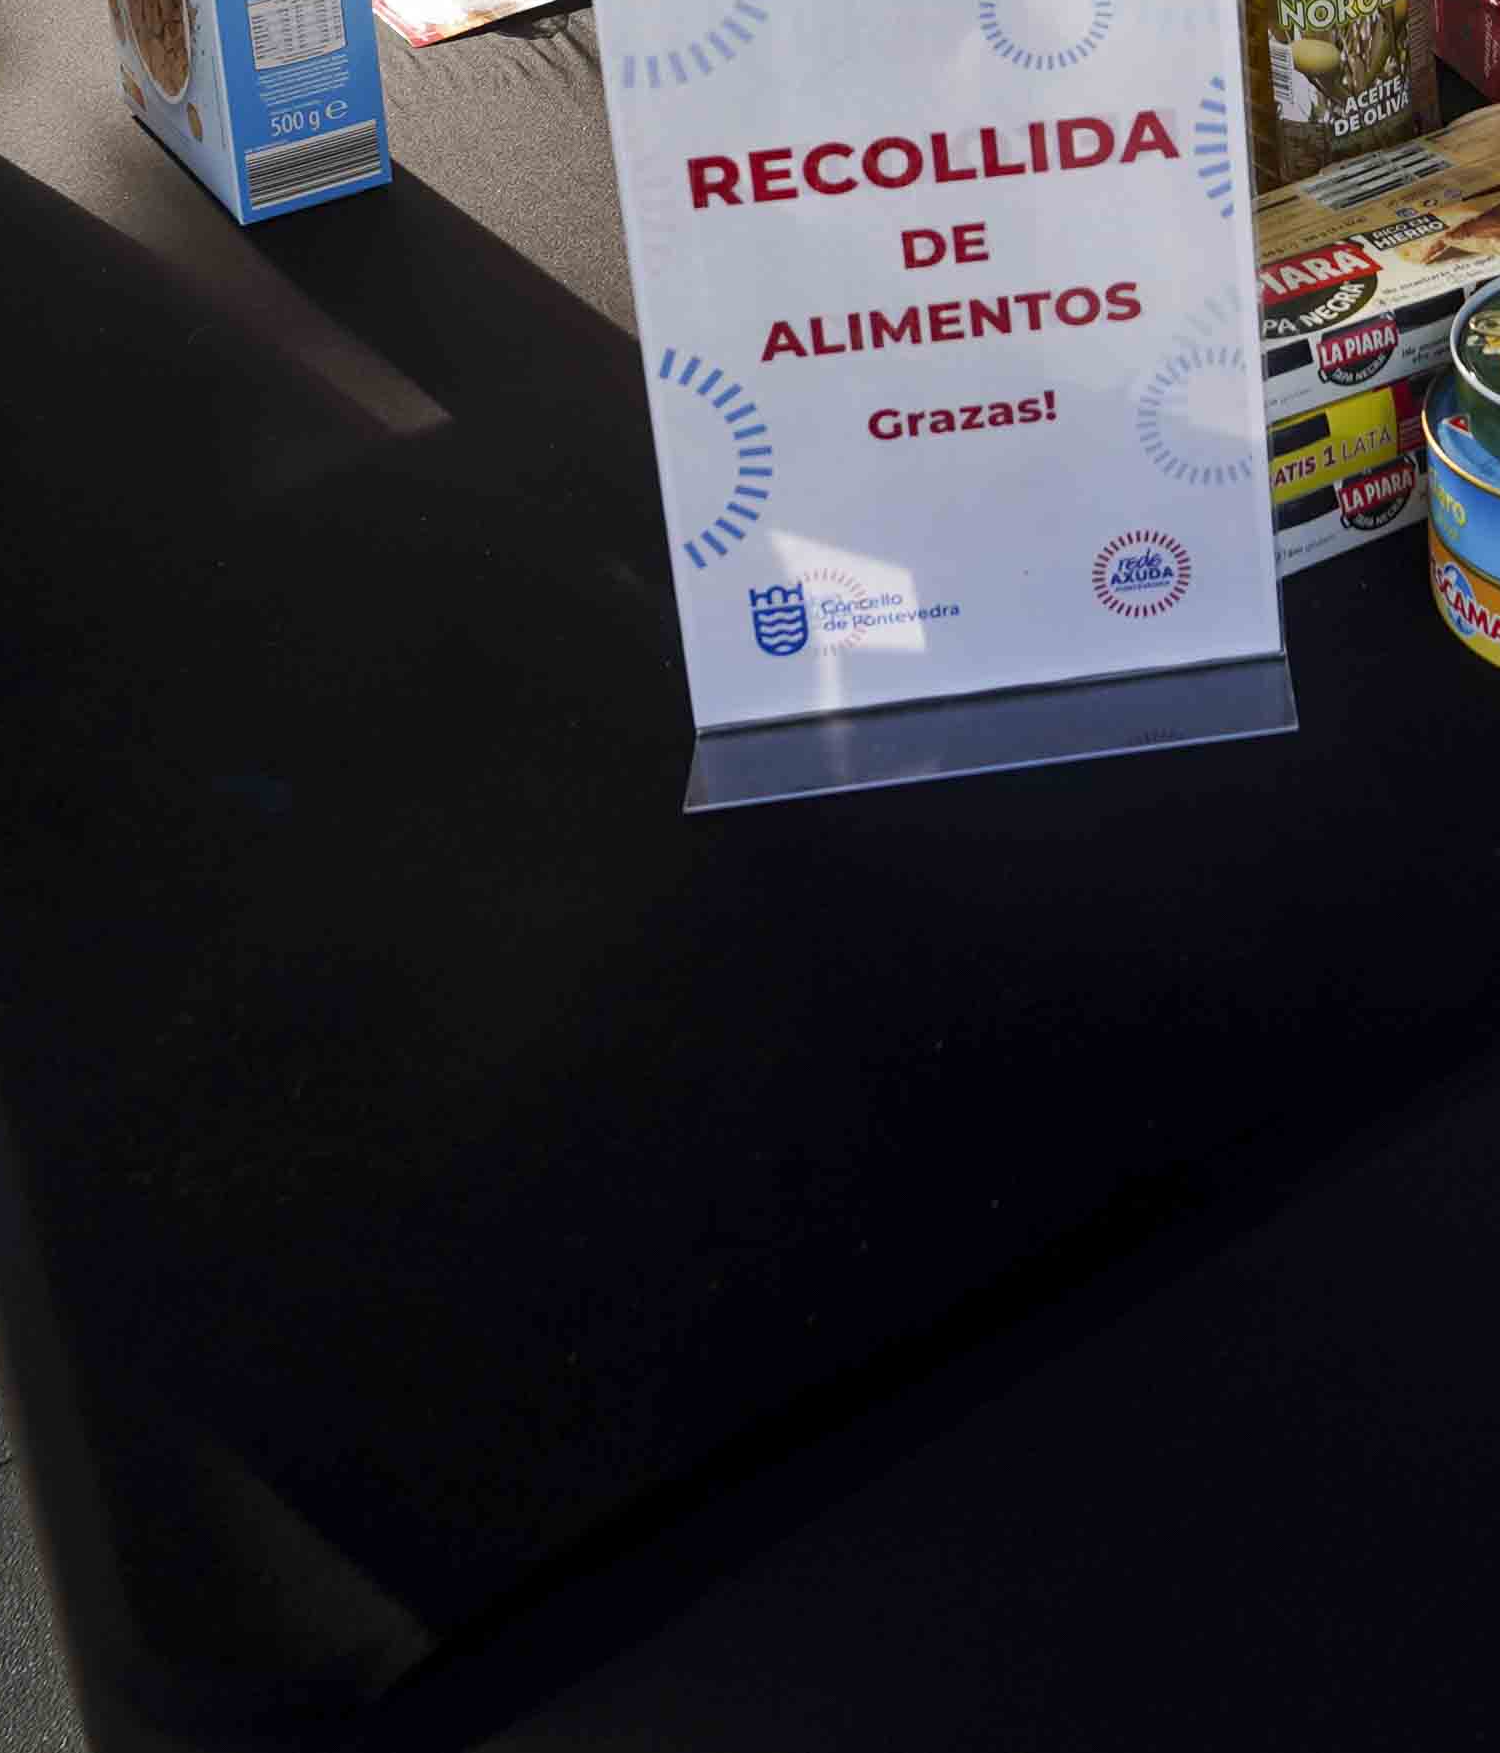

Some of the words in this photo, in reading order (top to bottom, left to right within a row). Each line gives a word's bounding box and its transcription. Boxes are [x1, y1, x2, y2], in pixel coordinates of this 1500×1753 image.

[1333, 113, 1361, 136] DE
[1363, 91, 1410, 125] OLIVA
[1345, 75, 1403, 113] ACEITE
[271, 110, 305, 136] 500
[309, 108, 320, 131] g
[686, 110, 1180, 209] RECOLLIDA
[901, 222, 991, 271] DE
[1374, 220, 1446, 249] HIERRO
[1260, 249, 1371, 296] IARA
[760, 280, 1143, 363] ALIMENTOS
[1261, 317, 1298, 335] PA
[1301, 281, 1365, 328] NEGRA
[1320, 342, 1345, 366] LA
[1348, 325, 1396, 356] PIARA
[866, 390, 1058, 441] Grazas!
[1271, 456, 1316, 487] ATIS
[1323, 444, 1336, 467] 1
[1340, 429, 1392, 458] LATA
[1341, 488, 1362, 510] LA
[1365, 469, 1414, 502] PIARA
[1110, 567, 1175, 586] AXUDA
[1117, 548, 1164, 571] rede
[821, 592, 904, 617] Concello
[823, 616, 849, 633] de
[852, 602, 961, 631] Pontevedra
